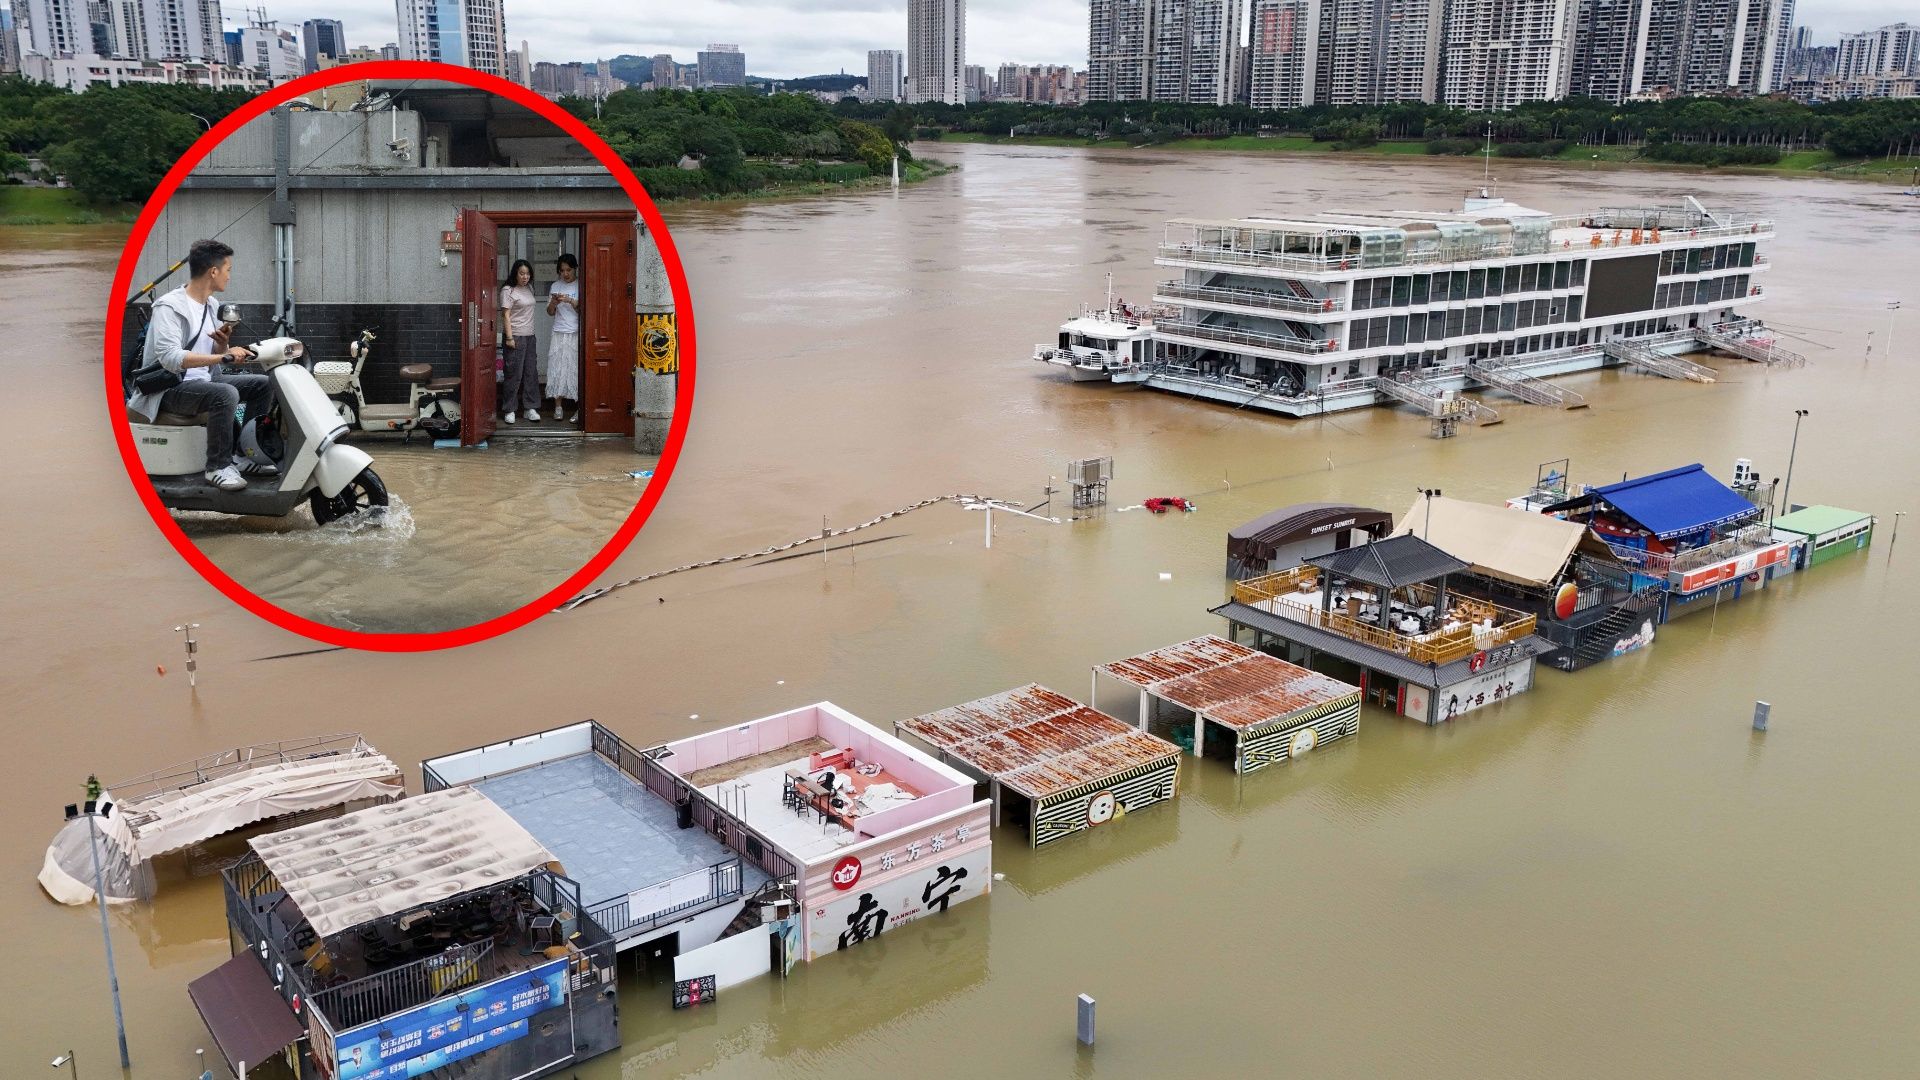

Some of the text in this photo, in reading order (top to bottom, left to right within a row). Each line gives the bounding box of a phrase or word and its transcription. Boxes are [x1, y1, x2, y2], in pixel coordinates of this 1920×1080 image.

[1311, 518, 1356, 534] SUNSET SUNRISE
[881, 823, 972, 871] 东方茶亭
[890, 907, 921, 922] NANNING
